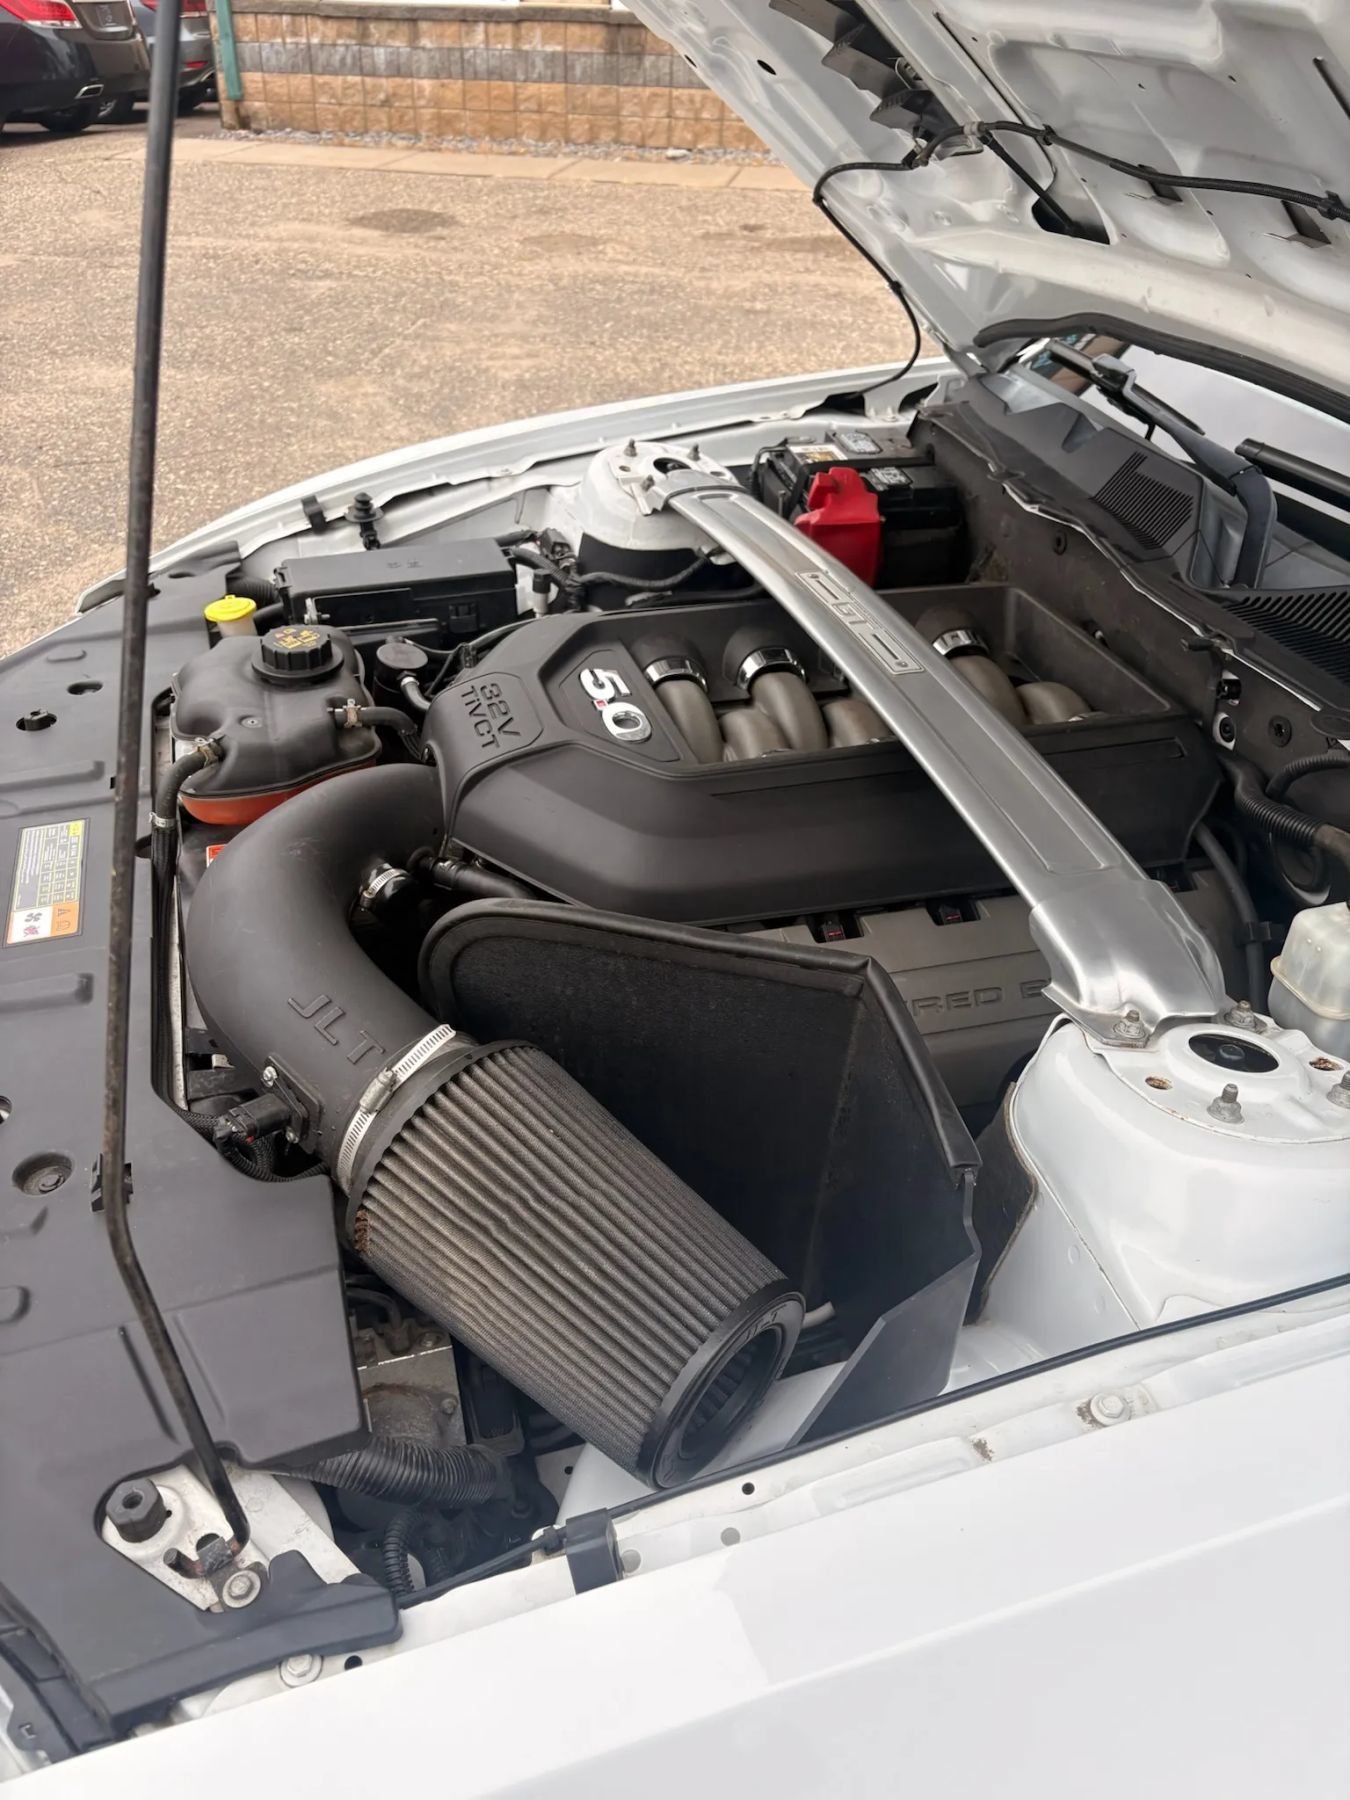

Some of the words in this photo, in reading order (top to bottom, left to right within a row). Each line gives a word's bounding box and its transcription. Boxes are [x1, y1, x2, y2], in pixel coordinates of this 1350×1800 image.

[461, 685, 500, 749] TiVCT
[480, 682, 521, 737] 32V
[579, 667, 652, 742] 5.0
[287, 994, 385, 1065] JLT
[904, 986, 1003, 1017] RED
[1018, 978, 1051, 999] B
